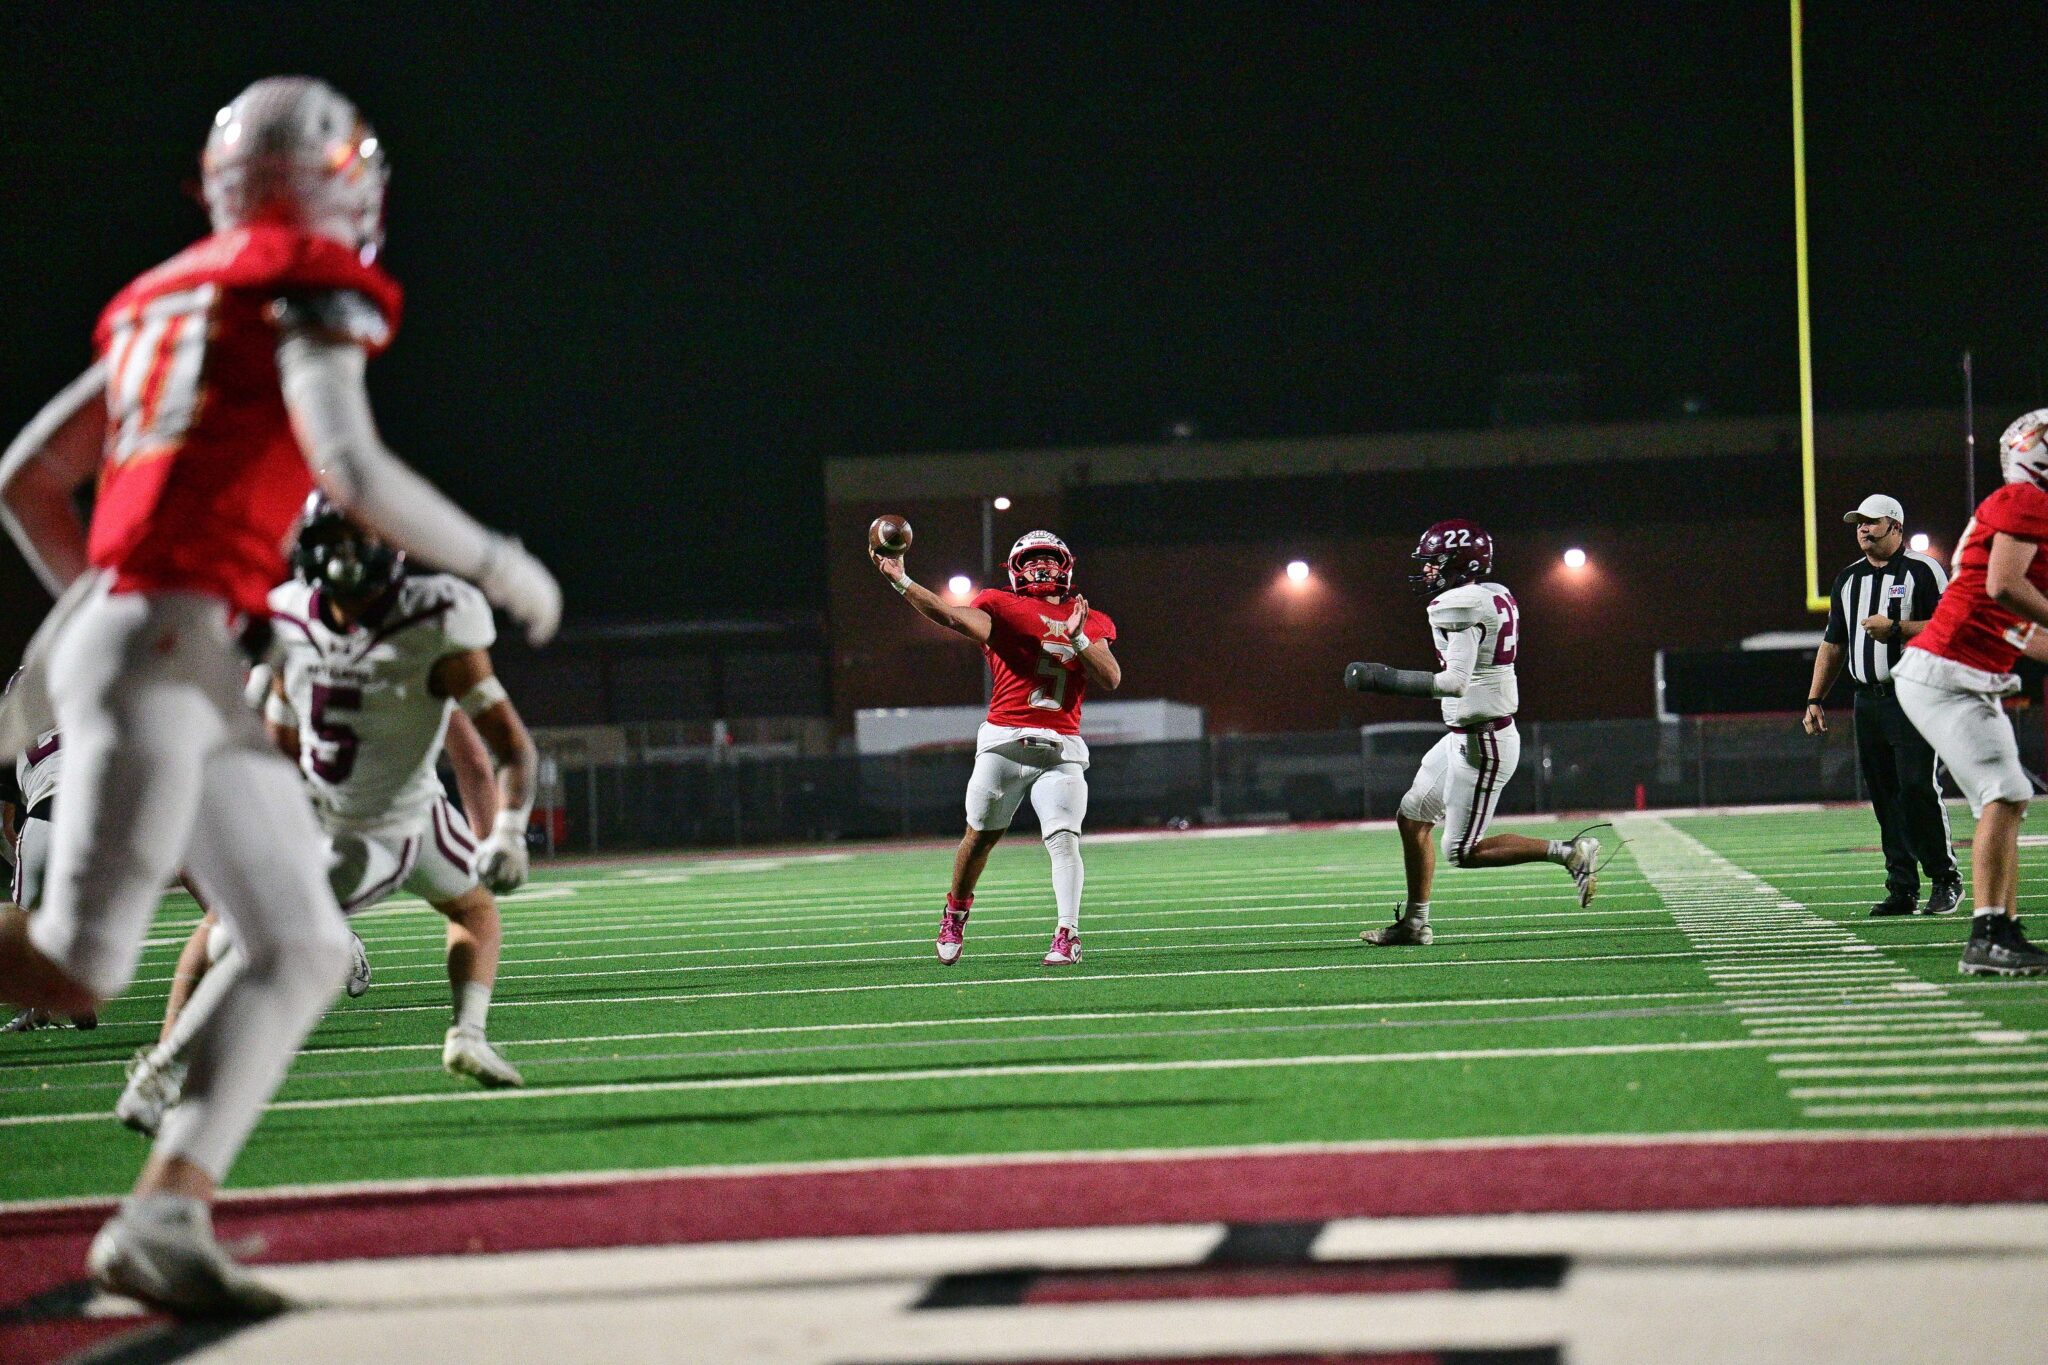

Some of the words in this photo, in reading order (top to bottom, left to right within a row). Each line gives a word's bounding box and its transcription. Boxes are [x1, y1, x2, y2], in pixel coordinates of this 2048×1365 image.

[1444, 529, 1471, 549] 22
[1028, 641, 1077, 711] 5
[311, 683, 362, 784] 5
